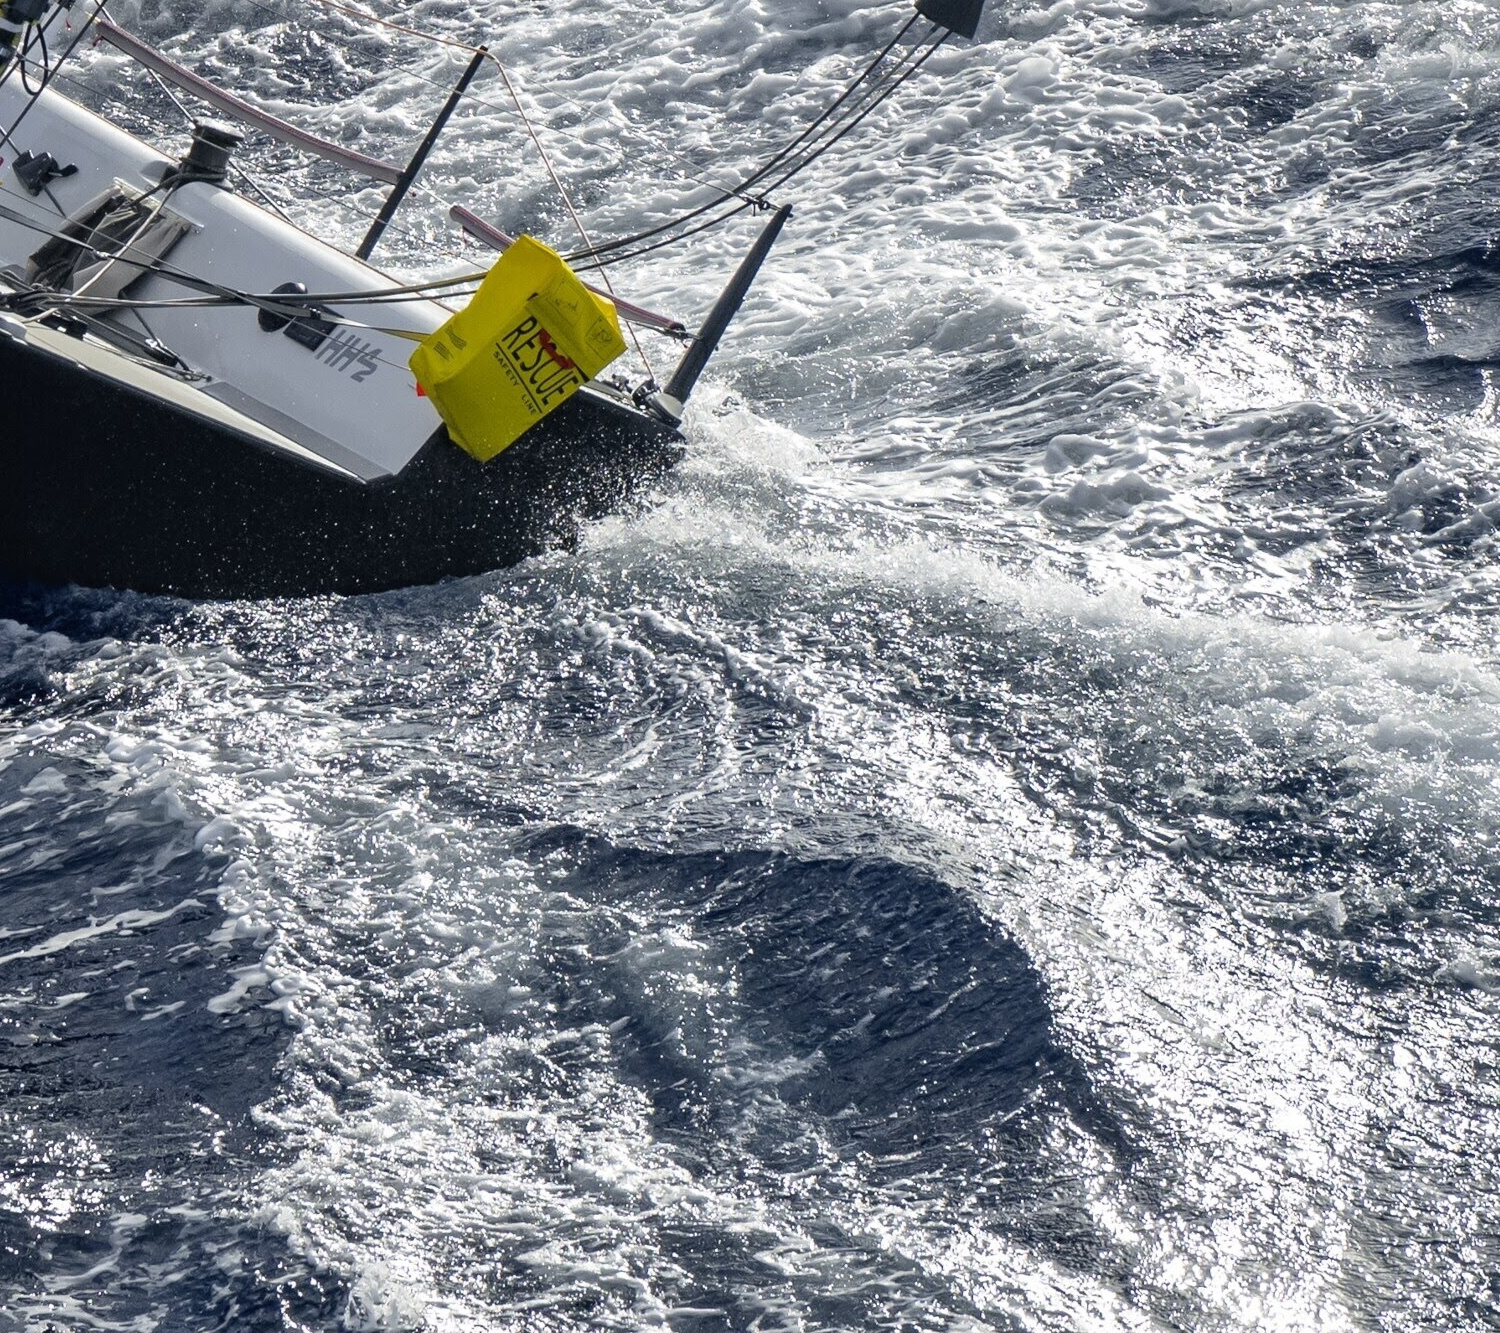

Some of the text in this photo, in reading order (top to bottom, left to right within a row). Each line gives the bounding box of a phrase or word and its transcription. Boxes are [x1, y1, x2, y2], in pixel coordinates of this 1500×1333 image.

[493, 351, 536, 415] SAFETY LINE
[502, 315, 578, 406] RESCUE
